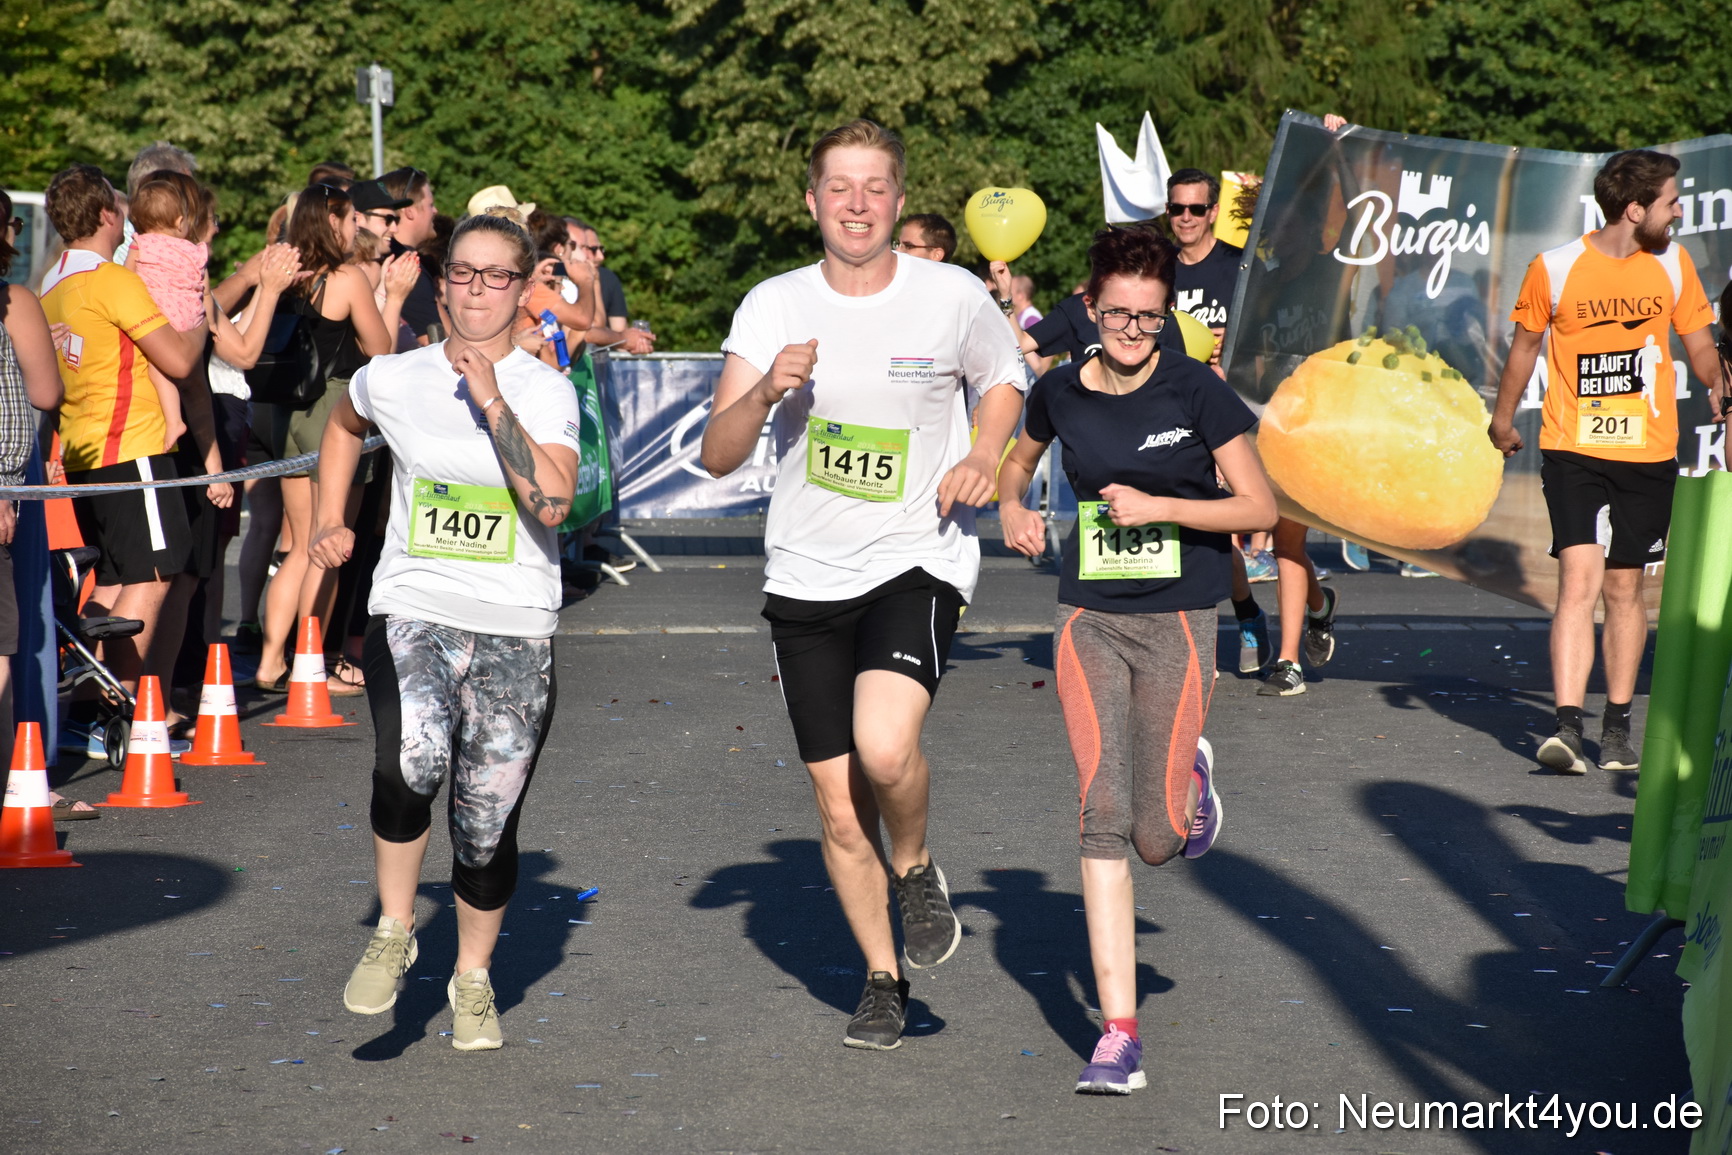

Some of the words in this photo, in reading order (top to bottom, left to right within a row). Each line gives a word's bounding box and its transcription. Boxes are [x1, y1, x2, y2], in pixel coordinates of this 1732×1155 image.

[979, 194, 1014, 212] Burgis
[1333, 190, 1490, 300] Burgis
[1577, 301, 1587, 319] BIT
[1588, 296, 1663, 318] WINGS
[1580, 353, 1633, 375] #LÄUFT
[1580, 378, 1602, 395] BEI
[1605, 374, 1632, 394] UNS
[1591, 416, 1629, 435] 201
[819, 445, 893, 481] 1415
[739, 475, 778, 493] AU
[824, 470, 858, 484] Hofbauer
[859, 479, 884, 488] Moritz
[427, 491, 461, 503] firmenlauf
[425, 507, 502, 541] 1407
[435, 537, 457, 546] Meier
[459, 540, 487, 549] Nadine
[1092, 527, 1164, 556] 1133
[1102, 557, 1122, 565] Willer
[1123, 556, 1154, 564] Sabrina
[902, 653, 922, 666] JAKO
